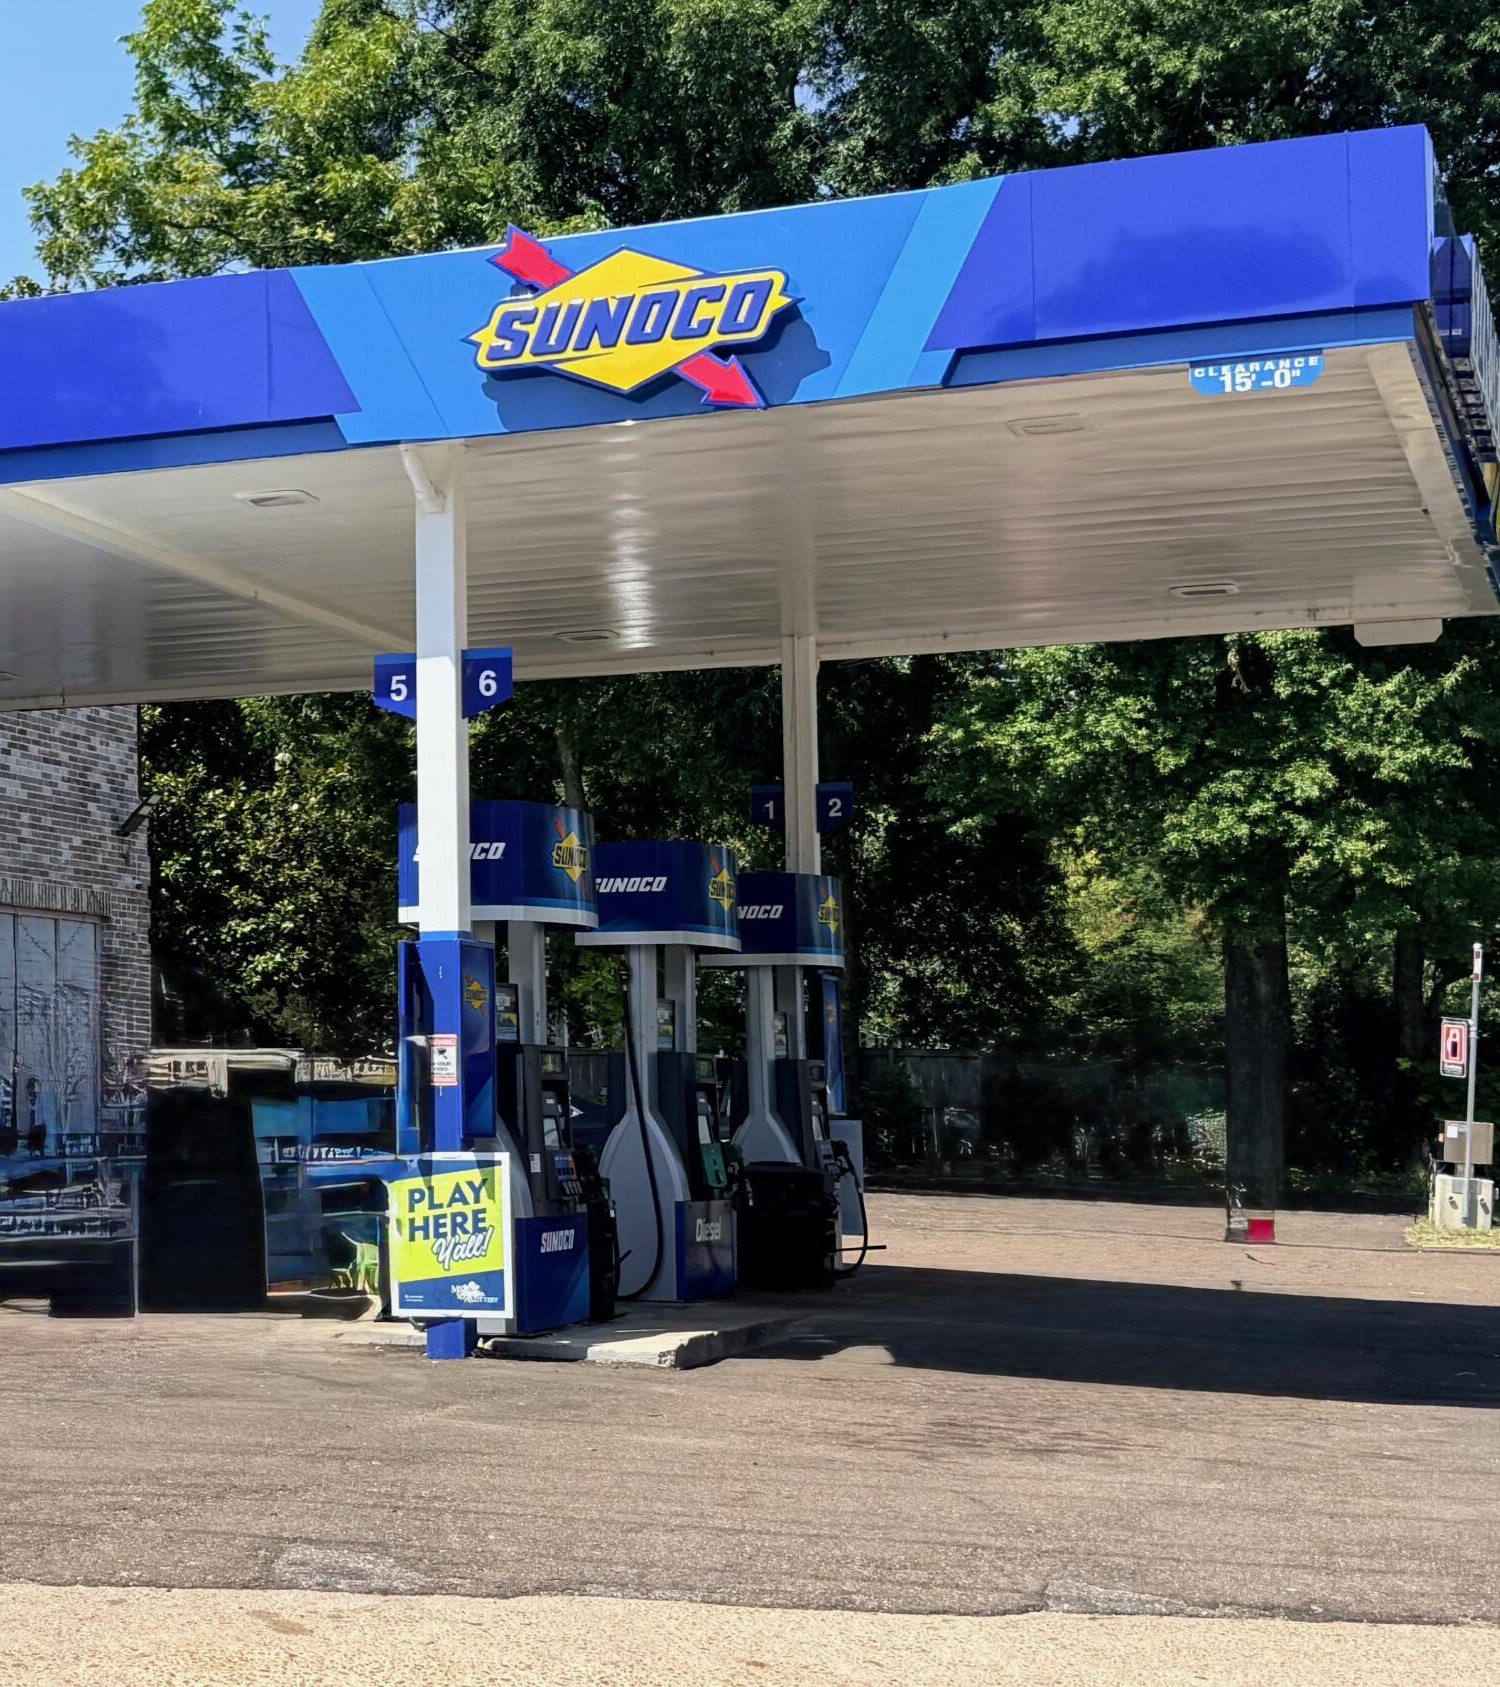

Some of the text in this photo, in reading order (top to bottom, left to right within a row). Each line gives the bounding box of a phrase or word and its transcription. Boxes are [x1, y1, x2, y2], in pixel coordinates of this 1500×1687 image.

[485, 278, 775, 362] SUNOCO
[1194, 356, 1319, 378] CLEARANCE
[390, 675, 408, 702] 5
[478, 670, 498, 697] 6
[764, 800, 774, 820] 1
[828, 798, 842, 817] 2
[737, 905, 784, 919] NOCO
[408, 1178, 488, 1213] PLAY
[408, 1207, 487, 1242] HERE
[695, 1216, 722, 1242] Diesel
[431, 1224, 495, 1271] Y'all!
[540, 1229, 575, 1253] SUNOCO
